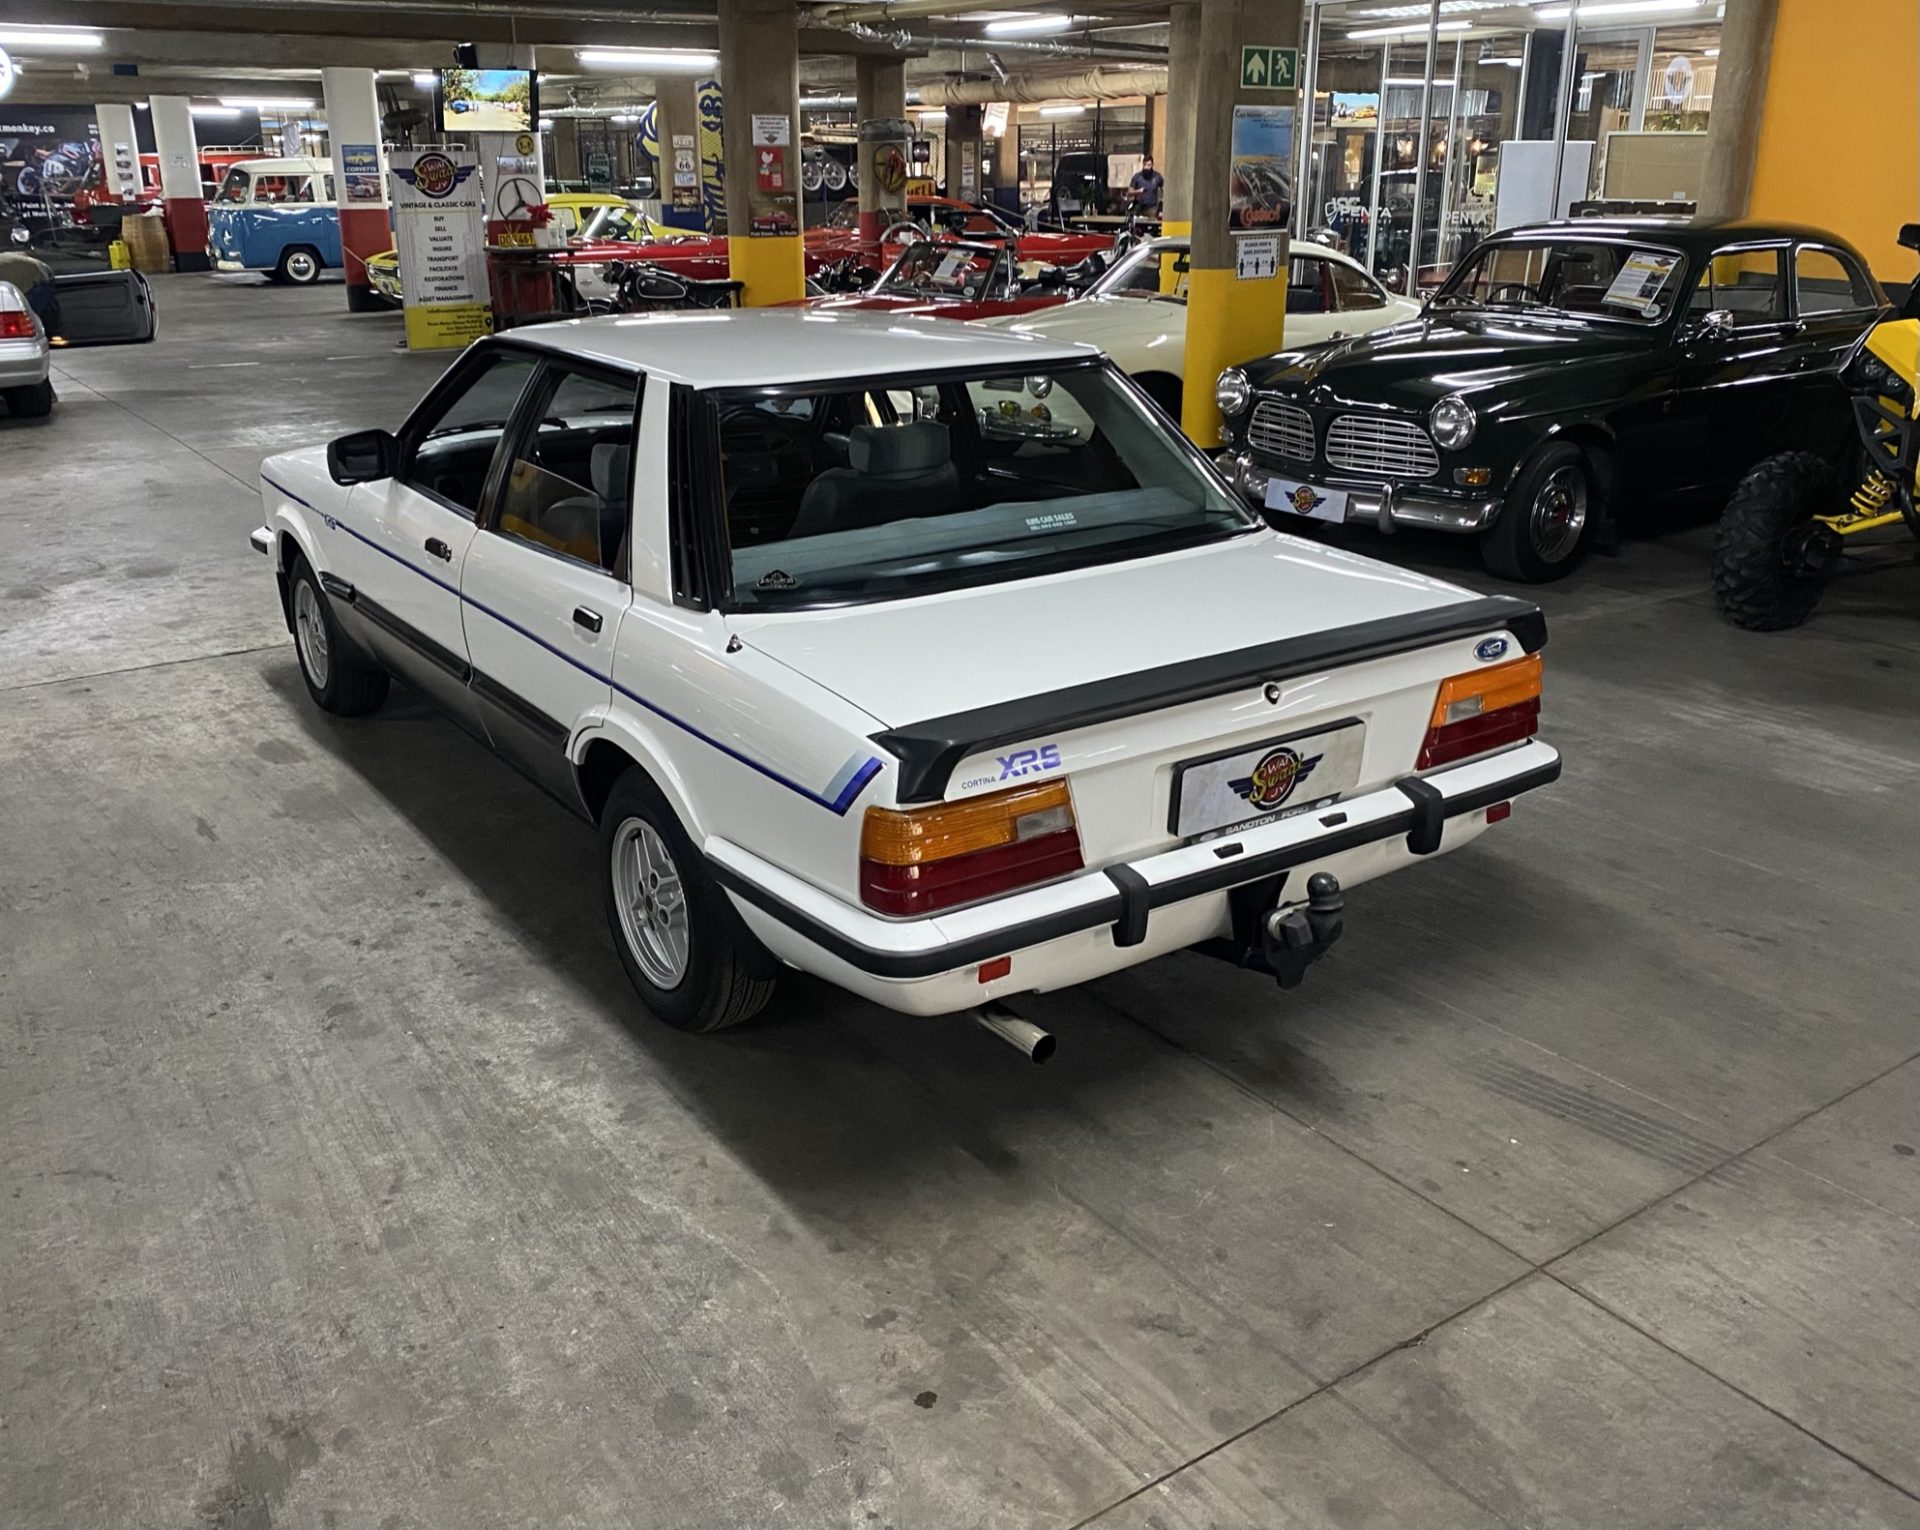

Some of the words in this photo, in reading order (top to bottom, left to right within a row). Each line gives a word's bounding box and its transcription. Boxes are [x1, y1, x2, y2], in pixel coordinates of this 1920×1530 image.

[679, 161, 691, 169] 66
[1054, 512, 1076, 522] SALES
[961, 776, 996, 790] CORTINA
[1271, 784, 1286, 798] JY
[1225, 814, 1276, 835] SANDTON
[1281, 806, 1309, 819] FORD
